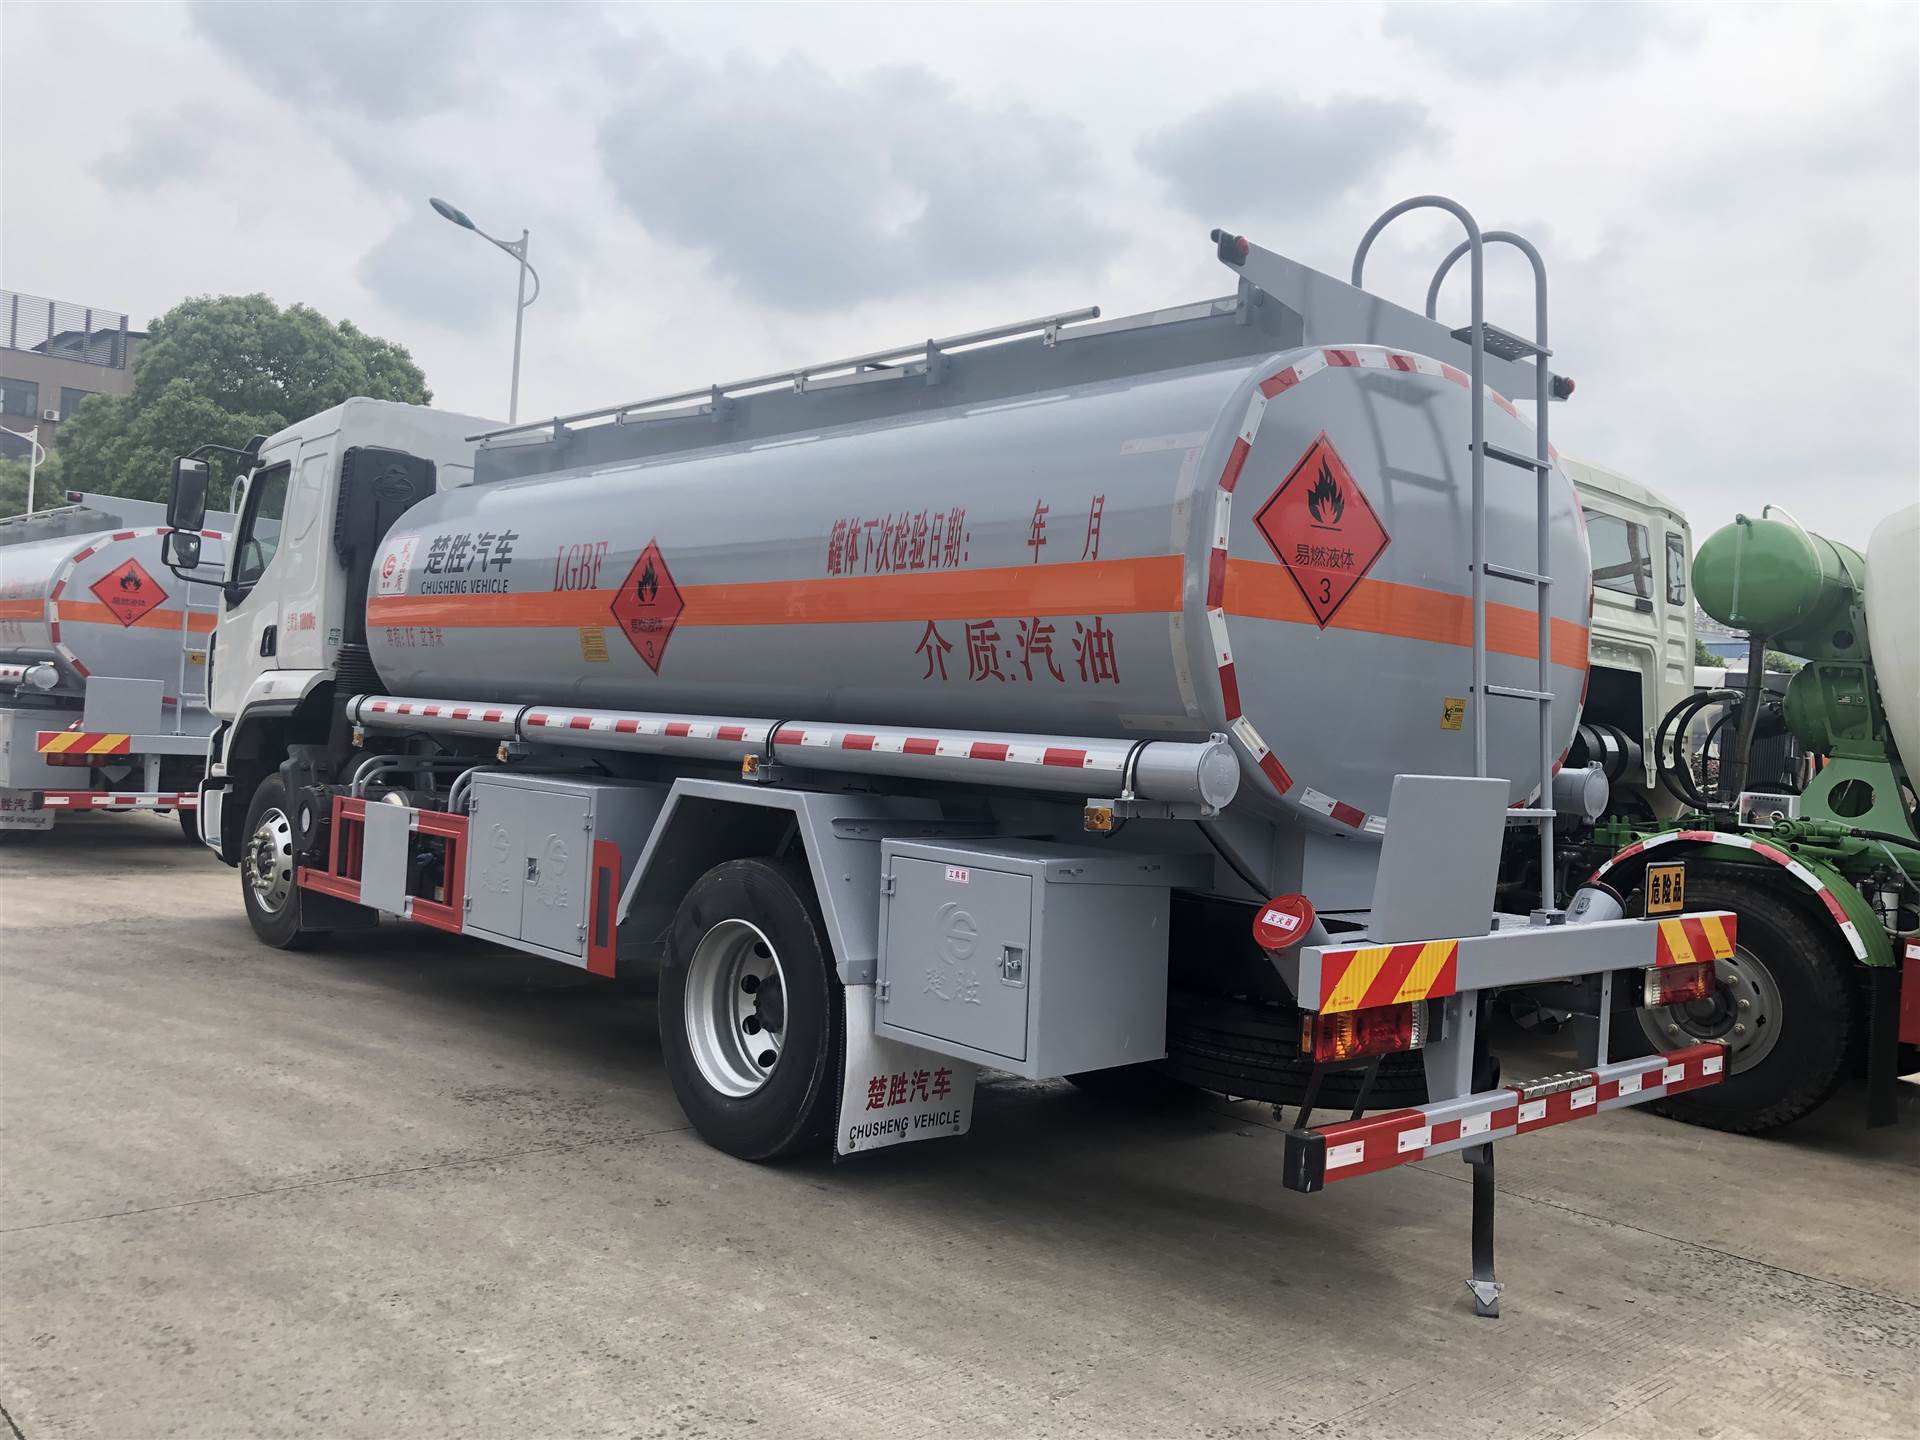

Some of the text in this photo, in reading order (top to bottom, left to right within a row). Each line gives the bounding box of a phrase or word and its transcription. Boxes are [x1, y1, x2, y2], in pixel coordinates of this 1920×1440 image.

[827, 493, 1106, 577] 罐体下次检验日期: 年 月
[423, 529, 519, 576] 楚胜汽车
[553, 540, 609, 592] LGBF
[1295, 543, 1355, 570] 易燃液体
[420, 578, 509, 596] CHUSHENG VEHICLE
[1319, 578, 1331, 605] 3
[646, 640, 654, 658] 3
[914, 616, 1120, 685] 介质:汽油
[948, 869, 968, 882] 工具箱
[1650, 872, 1683, 905] 危险品
[1268, 913, 1294, 927] 灭火器
[865, 1066, 953, 1111] 楚胜汽车
[849, 1109, 961, 1141] CHUSHENG VEHICLE
